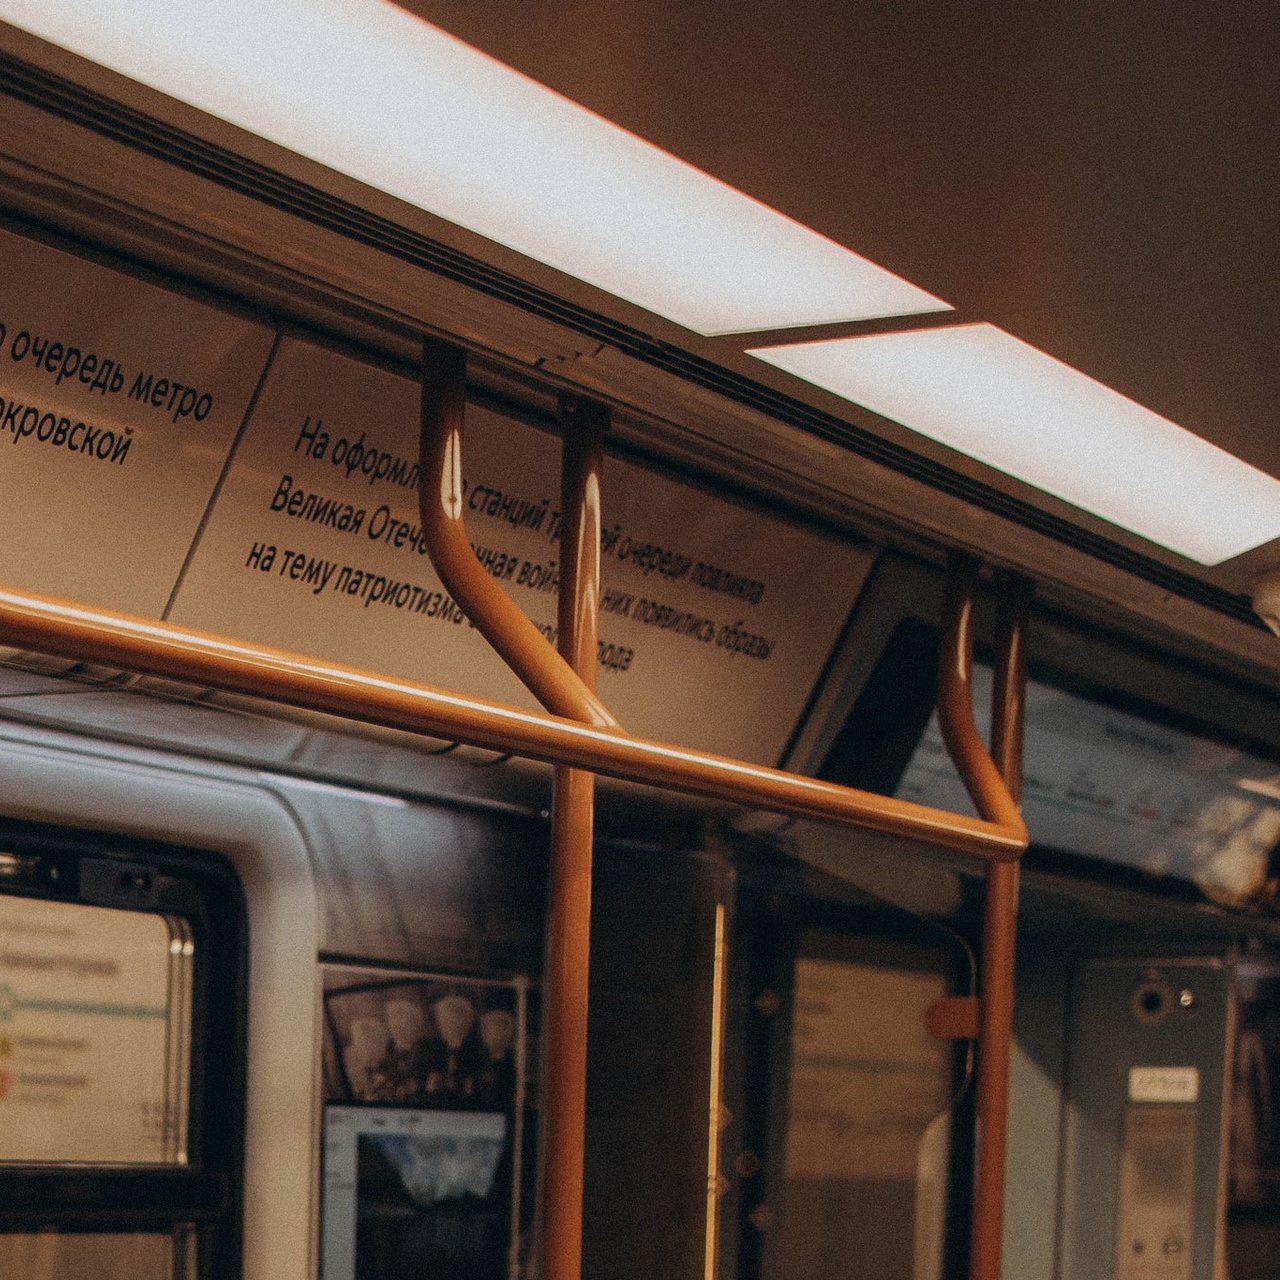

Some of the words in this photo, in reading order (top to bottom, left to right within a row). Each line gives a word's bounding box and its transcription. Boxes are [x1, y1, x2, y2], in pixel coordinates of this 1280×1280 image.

[10, 330, 125, 396] очередь
[127, 371, 214, 424] метро
[270, 473, 366, 535] Великая
[293, 415, 330, 460] На
[468, 483, 550, 531] станций
[245, 541, 278, 573] на
[278, 547, 338, 596] тему
[333, 563, 466, 625] патриотизма
